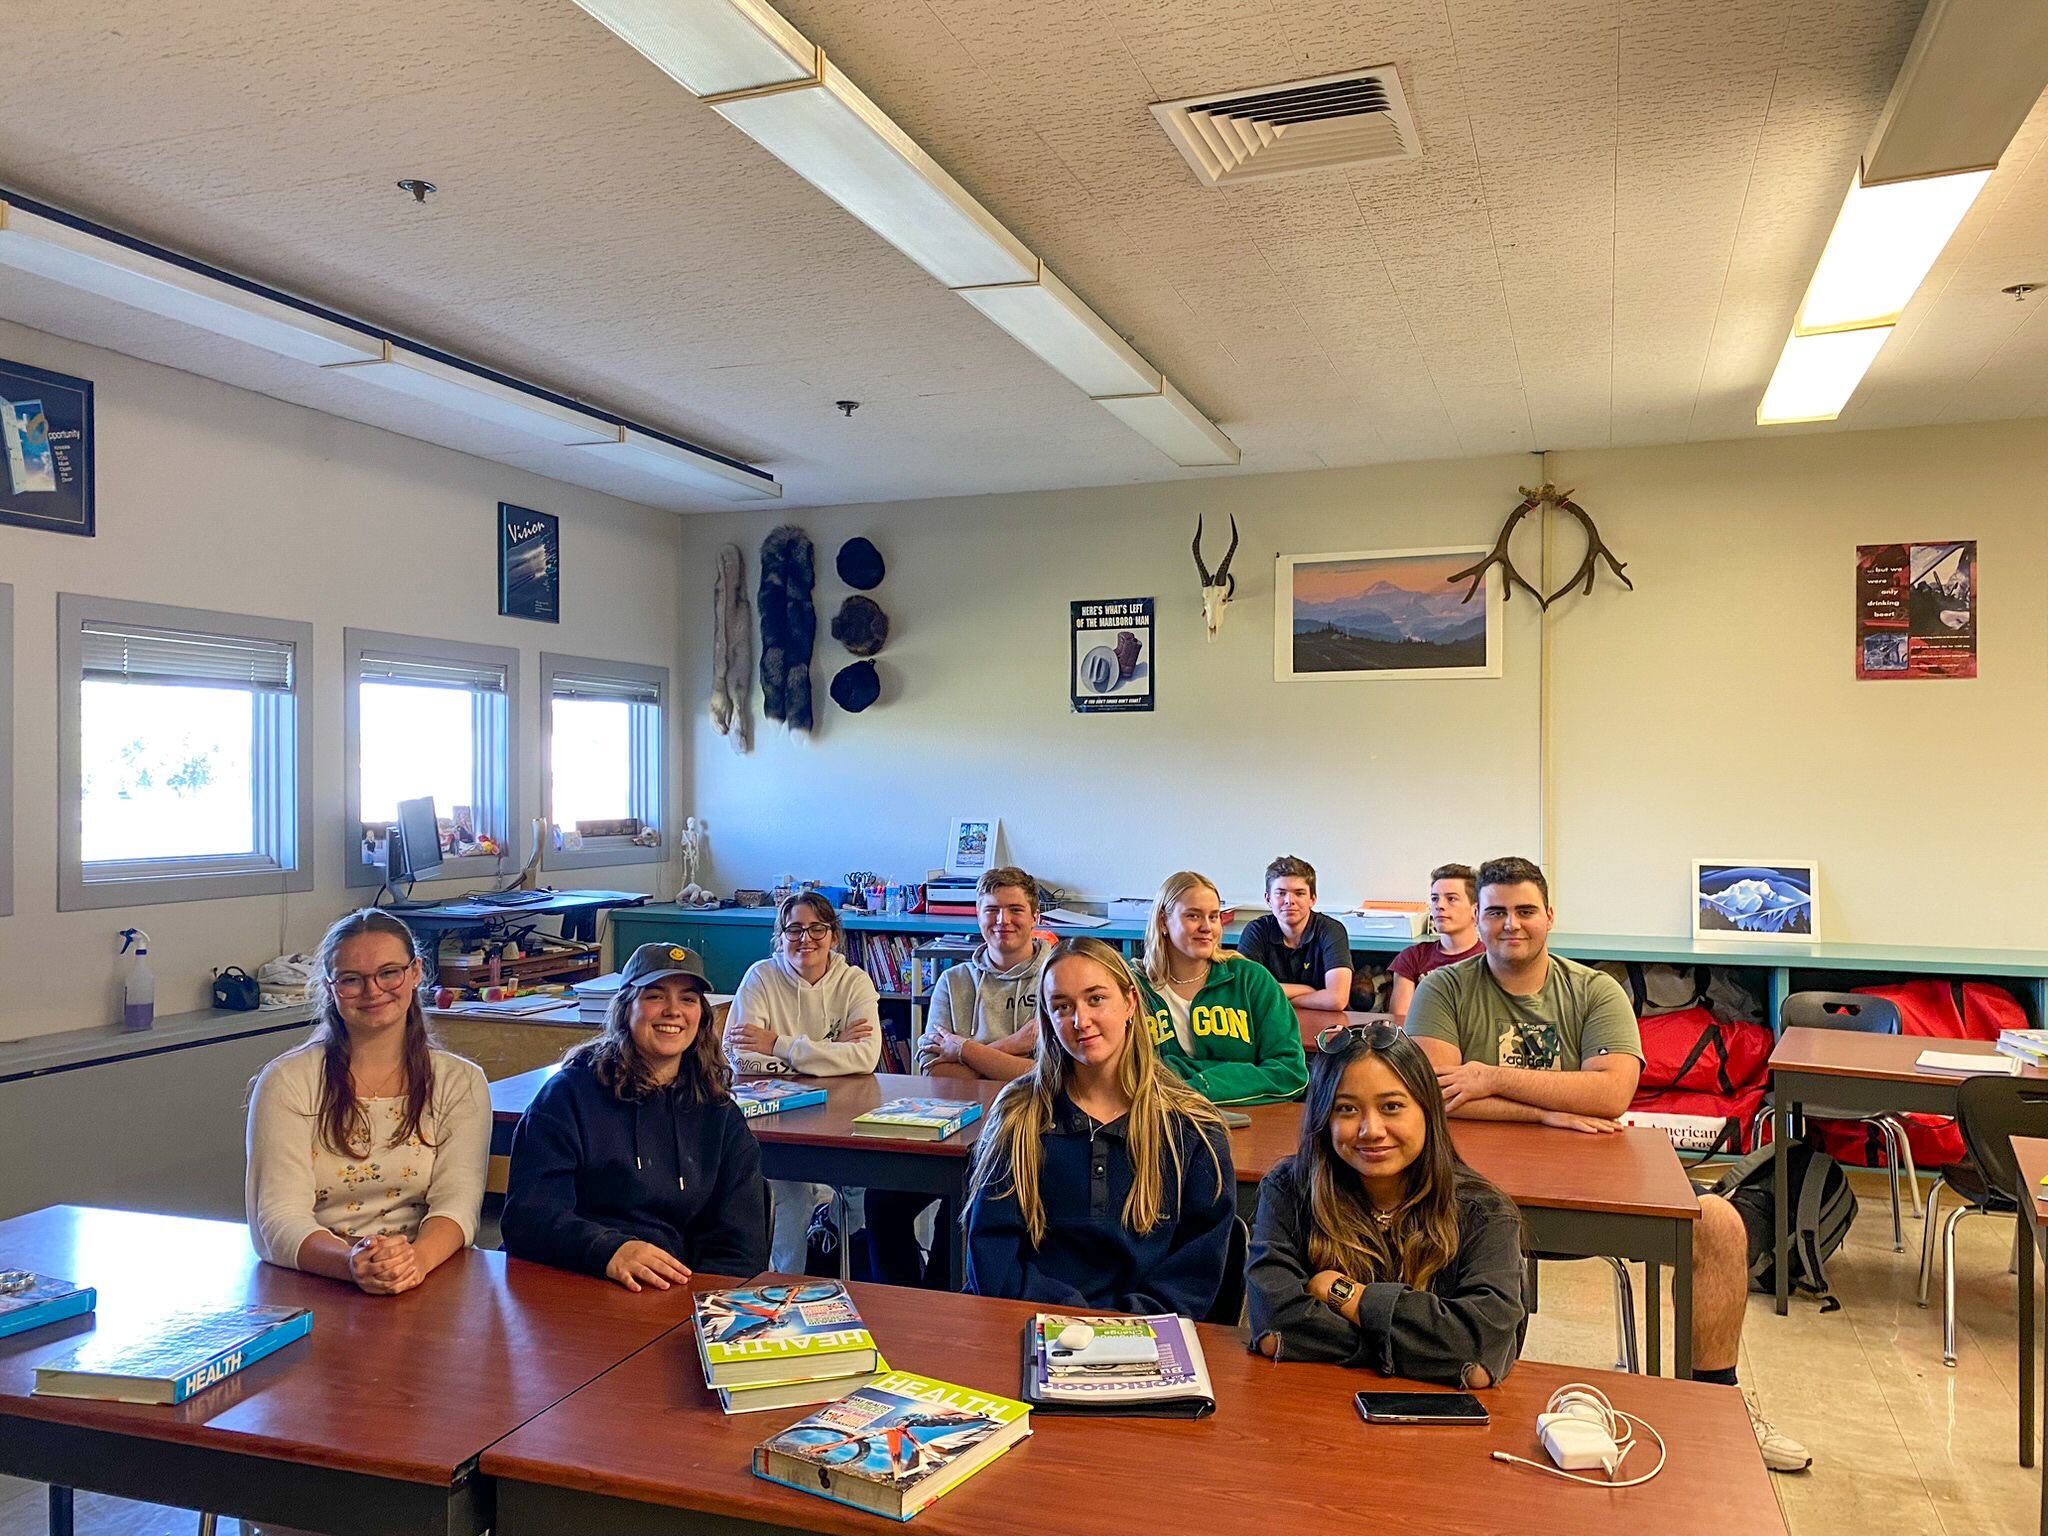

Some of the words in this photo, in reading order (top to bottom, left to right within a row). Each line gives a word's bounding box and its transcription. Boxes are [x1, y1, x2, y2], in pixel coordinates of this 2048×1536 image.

[508, 521, 545, 543] Vision
[1881, 588, 1899, 596] only
[1081, 605, 1103, 616] HERE'S
[1104, 604, 1127, 615] WHAT'S
[1129, 603, 1143, 614] LEFT
[1076, 618, 1085, 628] OF
[1086, 617, 1098, 627] THE
[1099, 616, 1133, 627] MARLBORO
[1135, 615, 1150, 626] MAN
[1006, 994, 1037, 1009] NAS
[743, 1100, 780, 1118] HEALTH
[943, 1117, 961, 1138] HEALTH
[1679, 1137, 1713, 1150] Cros
[722, 1331, 865, 1356] HEALTH
[184, 1350, 243, 1397] HEALTH
[1041, 1375, 1197, 1391] WORKBOOK
[879, 1374, 1010, 1421] HEALTH
